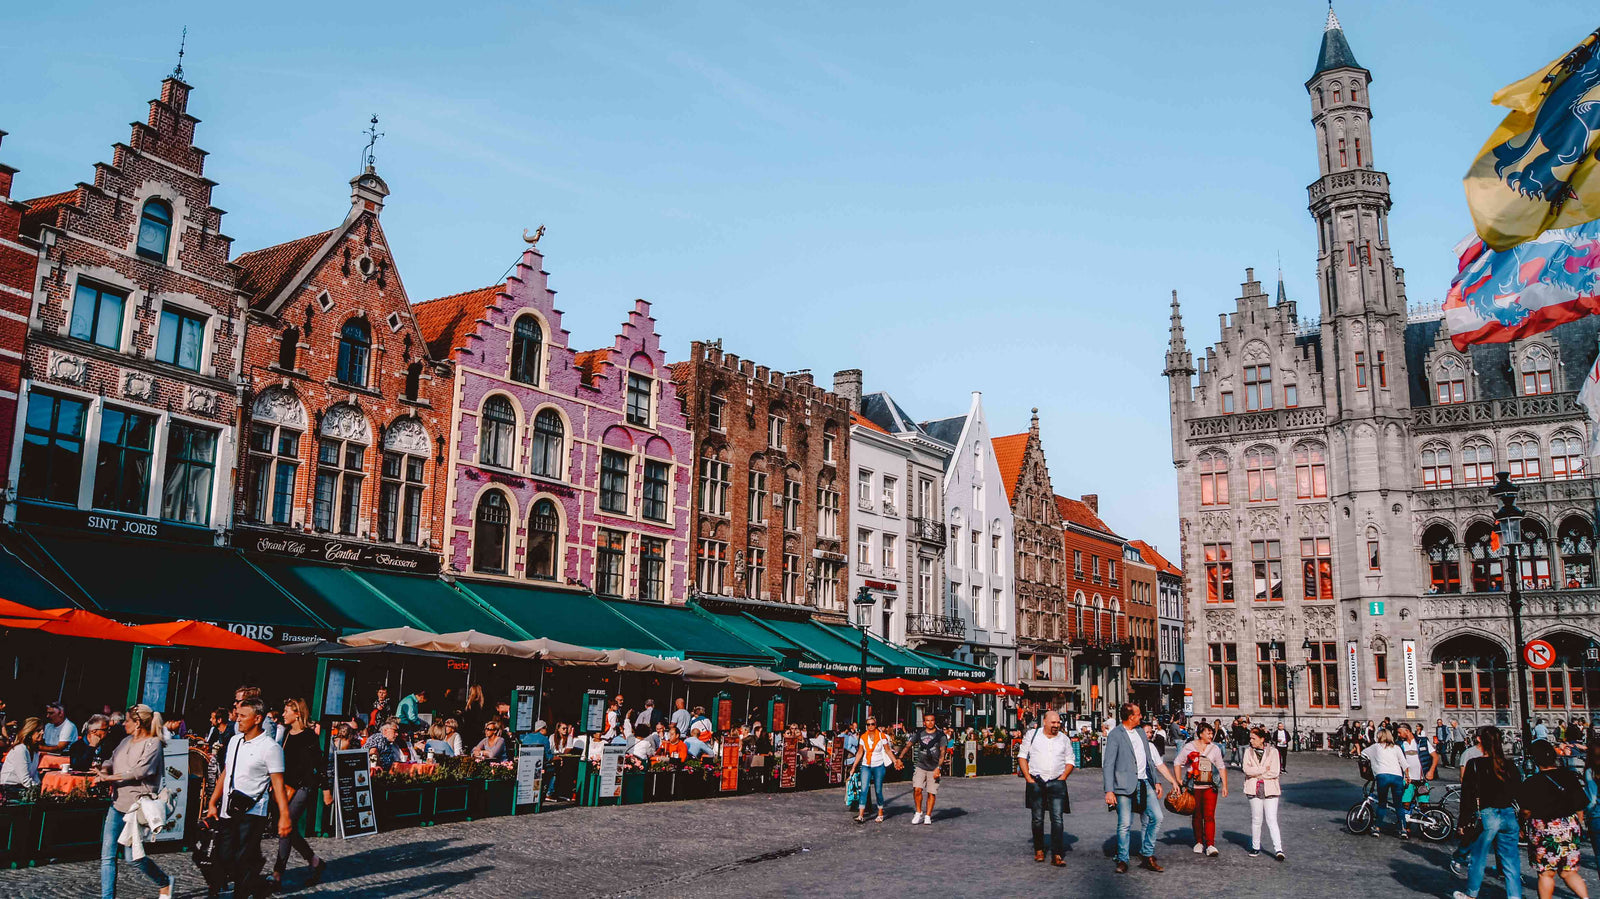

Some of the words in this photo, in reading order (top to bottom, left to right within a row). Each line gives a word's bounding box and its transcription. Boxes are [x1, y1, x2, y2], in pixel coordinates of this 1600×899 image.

[88, 516, 118, 531] SINT
[122, 521, 158, 536] JORIS
[257, 538, 287, 552] Grand
[325, 541, 361, 561] Central
[376, 554, 417, 568] Brasserie
[282, 632, 321, 642] Brasserie
[798, 661, 822, 669] Brasserie
[904, 667, 917, 675] PETIT
[948, 669, 969, 677] Friterie
[1350, 654, 1358, 701] HISTORIUM
[1407, 653, 1415, 701] HISTORIUM
